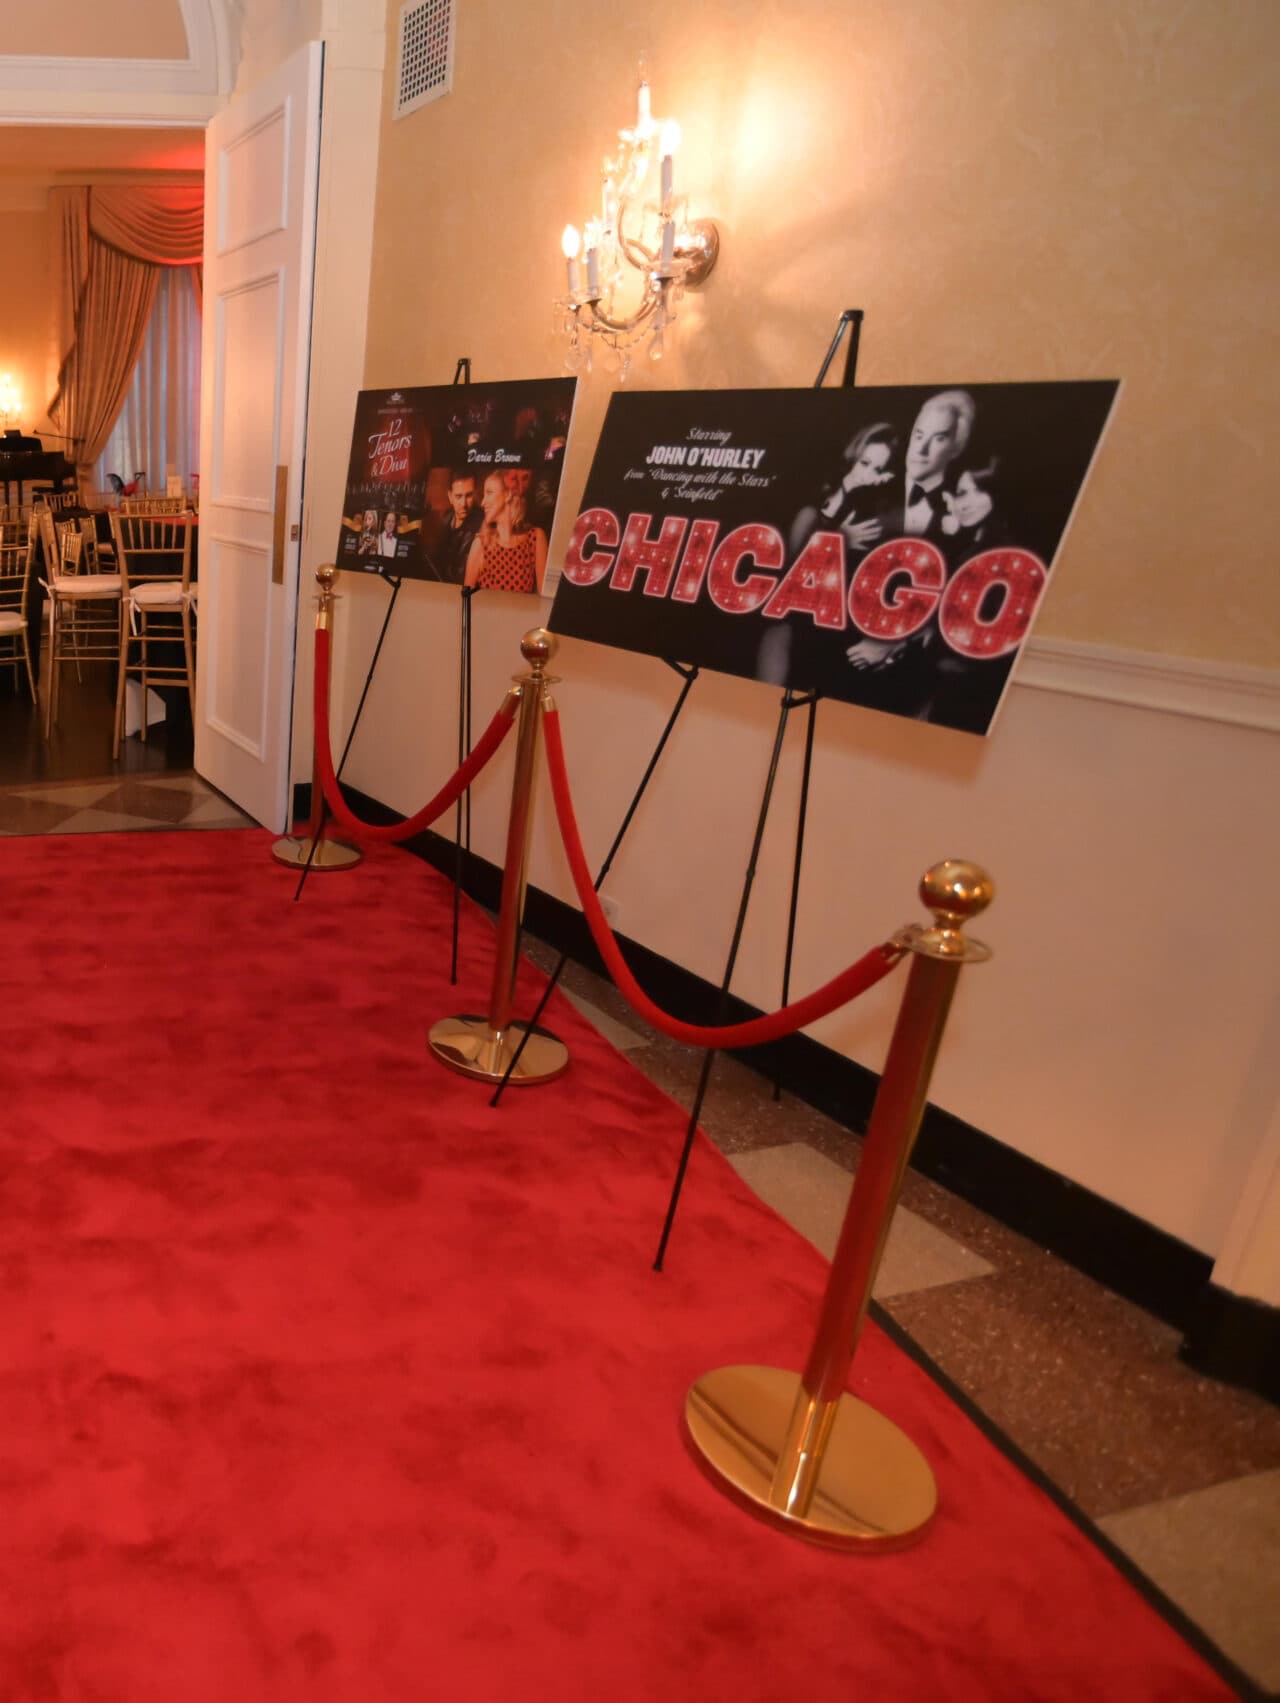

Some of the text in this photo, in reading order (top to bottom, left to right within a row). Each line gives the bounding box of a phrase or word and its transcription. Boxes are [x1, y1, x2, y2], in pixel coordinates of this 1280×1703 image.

[388, 419, 402, 437] 12
[686, 427, 732, 446] Starring
[368, 432, 412, 459] Tenors
[467, 449, 492, 463] Darin
[646, 446, 765, 469] JOHN O'HURLEY
[624, 468, 645, 480] from
[693, 471, 719, 484] with
[719, 472, 737, 485] the
[562, 507, 1050, 660] CHICAGO
